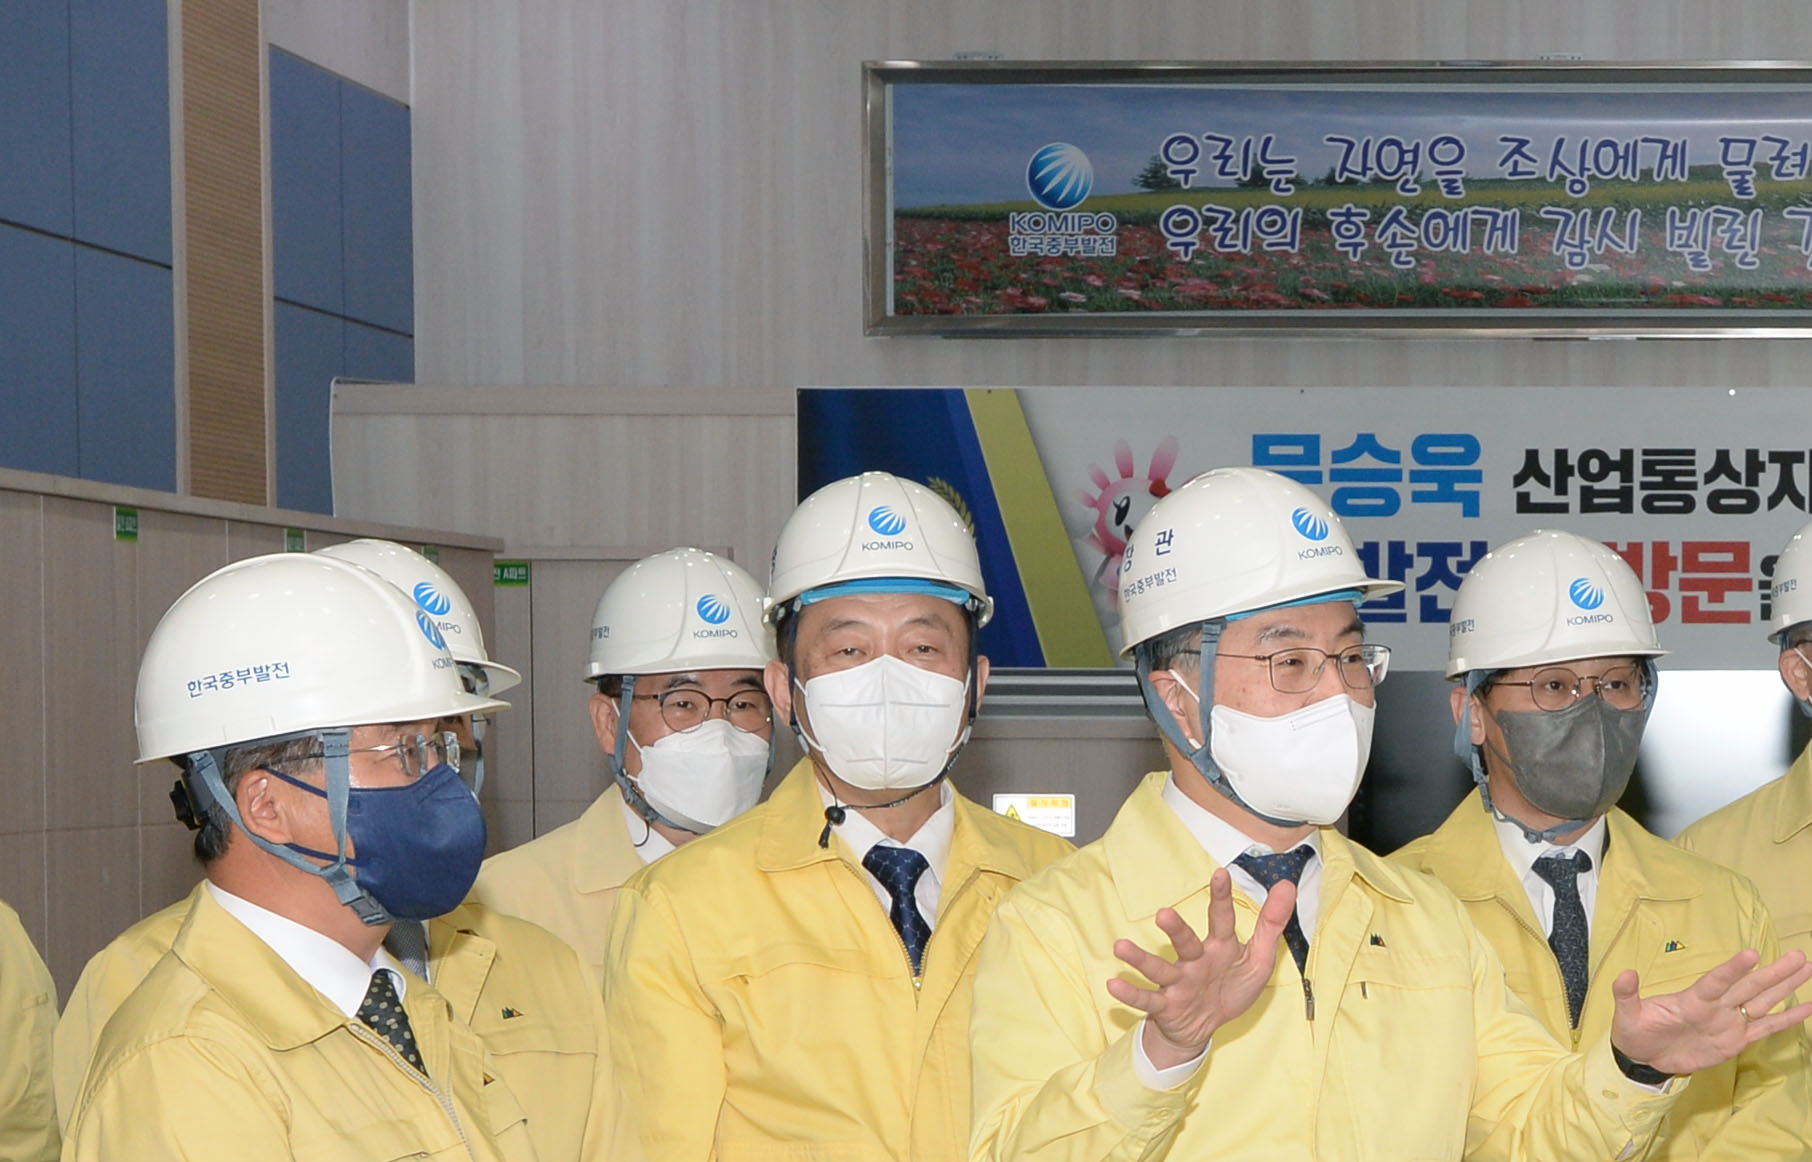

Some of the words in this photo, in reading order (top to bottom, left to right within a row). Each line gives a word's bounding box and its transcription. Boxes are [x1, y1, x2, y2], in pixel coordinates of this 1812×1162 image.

[1160, 134, 1296, 194] 우리는
[1325, 134, 1466, 198] 자연을
[1497, 134, 1687, 198] 조상에게
[1009, 213, 1115, 234] KOMIPO
[1009, 234, 1117, 257] 한국중부발전
[1159, 204, 1302, 259] 우리의
[1327, 205, 1519, 269] 후손에게
[1541, 206, 1641, 270] 잠시
[1665, 208, 1764, 270] 빌린
[861, 540, 914, 552] KOMIPO
[1297, 545, 1343, 561] KOMIPO
[1355, 540, 1488, 624] 발전
[1600, 540, 1780, 624] 방문
[1566, 614, 1614, 627] KOMIPO
[692, 628, 739, 640] KOMIPO
[186, 661, 291, 698] 한국중부발전
